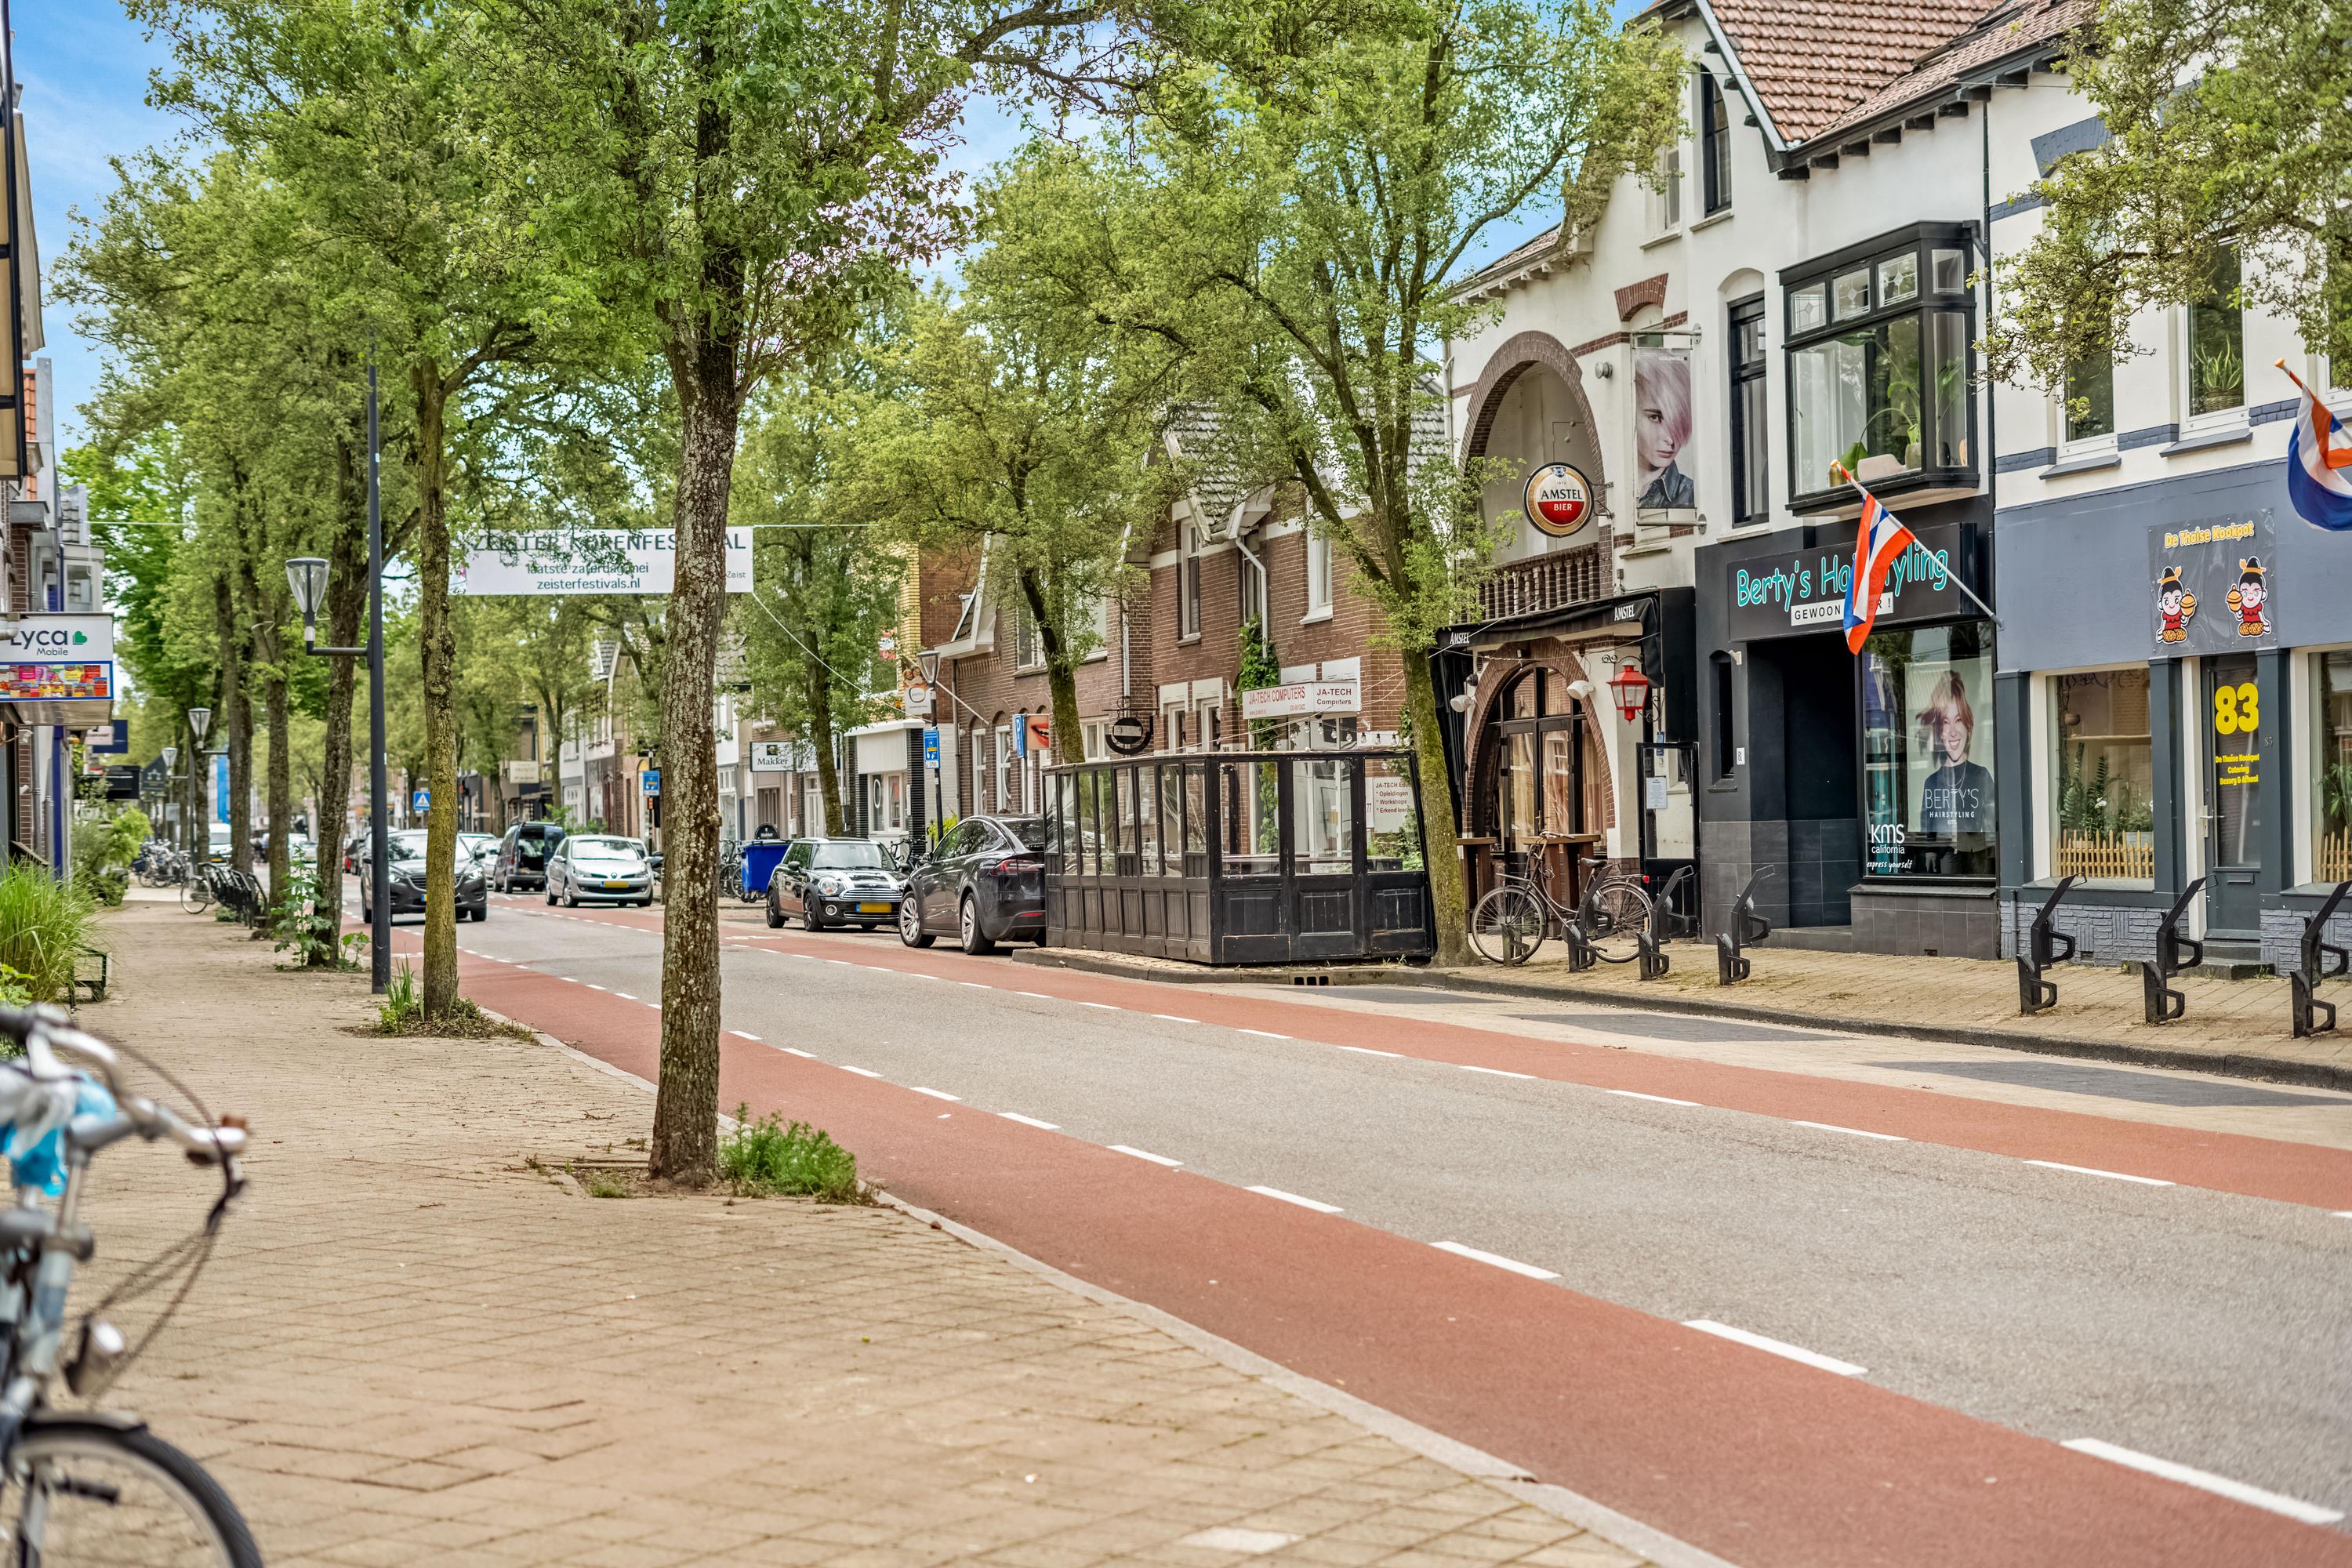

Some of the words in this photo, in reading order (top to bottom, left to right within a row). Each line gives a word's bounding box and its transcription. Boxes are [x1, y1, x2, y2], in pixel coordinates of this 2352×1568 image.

[1541, 488, 1583, 500] AMSTEL
[2165, 533, 2179, 549] De
[2179, 526, 2211, 546] Thaise
[2211, 521, 2255, 542] Kookpot
[537, 578, 641, 590] zeisterfestivals.nl
[1737, 560, 1811, 612] Berty's
[1613, 603, 1635, 622] AMSTEL
[1795, 604, 1842, 620] GEWOON
[1449, 631, 1470, 645] AMSTEL
[36, 648, 68, 656] Mobile
[1248, 690, 1271, 705] JA-TECH
[1271, 686, 1305, 702] COMPUTERS
[2215, 682, 2259, 735] 83
[757, 757, 789, 766] Makker
[1924, 789, 1979, 809] BERTY'S
[1871, 844, 1905, 854] california
[1866, 860, 1888, 871] express
[1888, 858, 1913, 873] yourself
